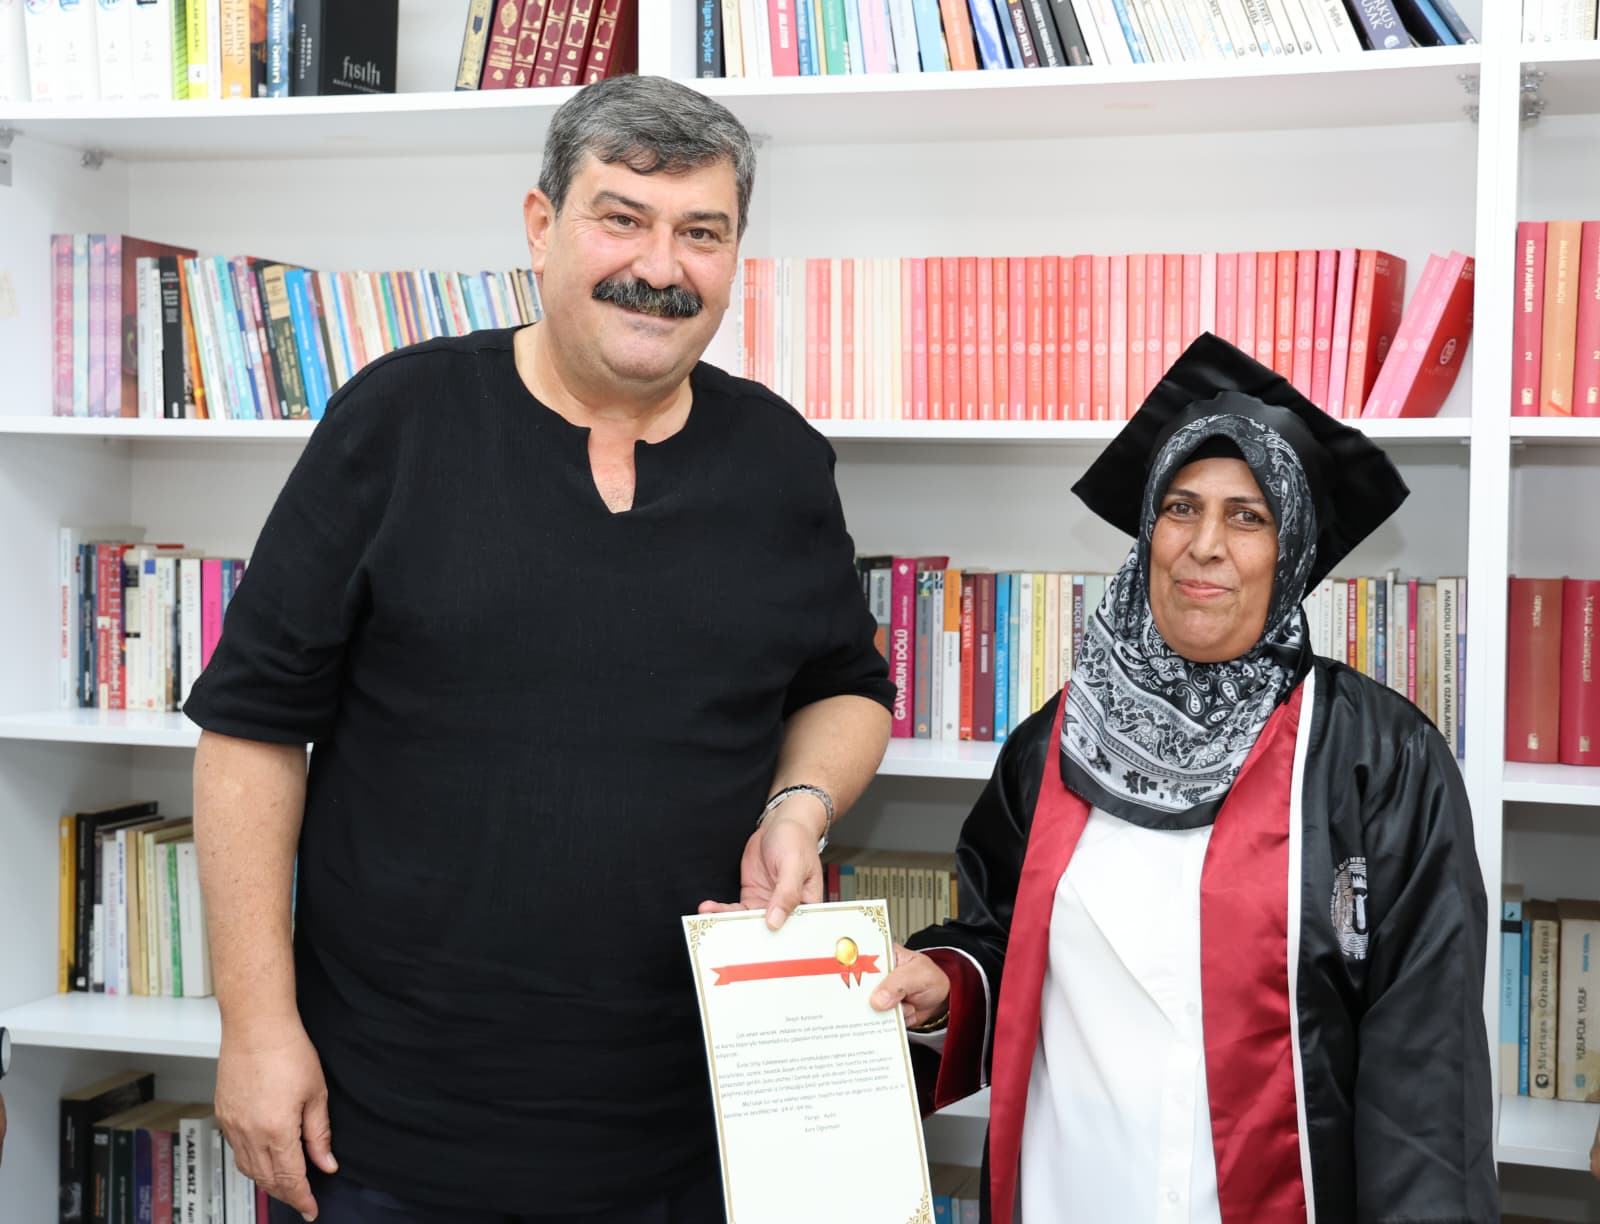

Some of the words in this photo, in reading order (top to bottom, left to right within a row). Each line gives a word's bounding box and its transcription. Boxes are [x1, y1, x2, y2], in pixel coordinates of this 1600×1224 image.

[1525, 351, 1533, 361] 2
[1072, 596, 1082, 630] KÜÇÜK
[1443, 589, 1452, 630] ANADOLU
[893, 628, 908, 660] DÖLÜ
[894, 661, 907, 720] GAVURUN
[1443, 673, 1452, 684] VE
[1538, 925, 1550, 965] Kemal
[1537, 969, 1549, 1009] Orhan
[1576, 986, 1588, 1013] YUSUF
